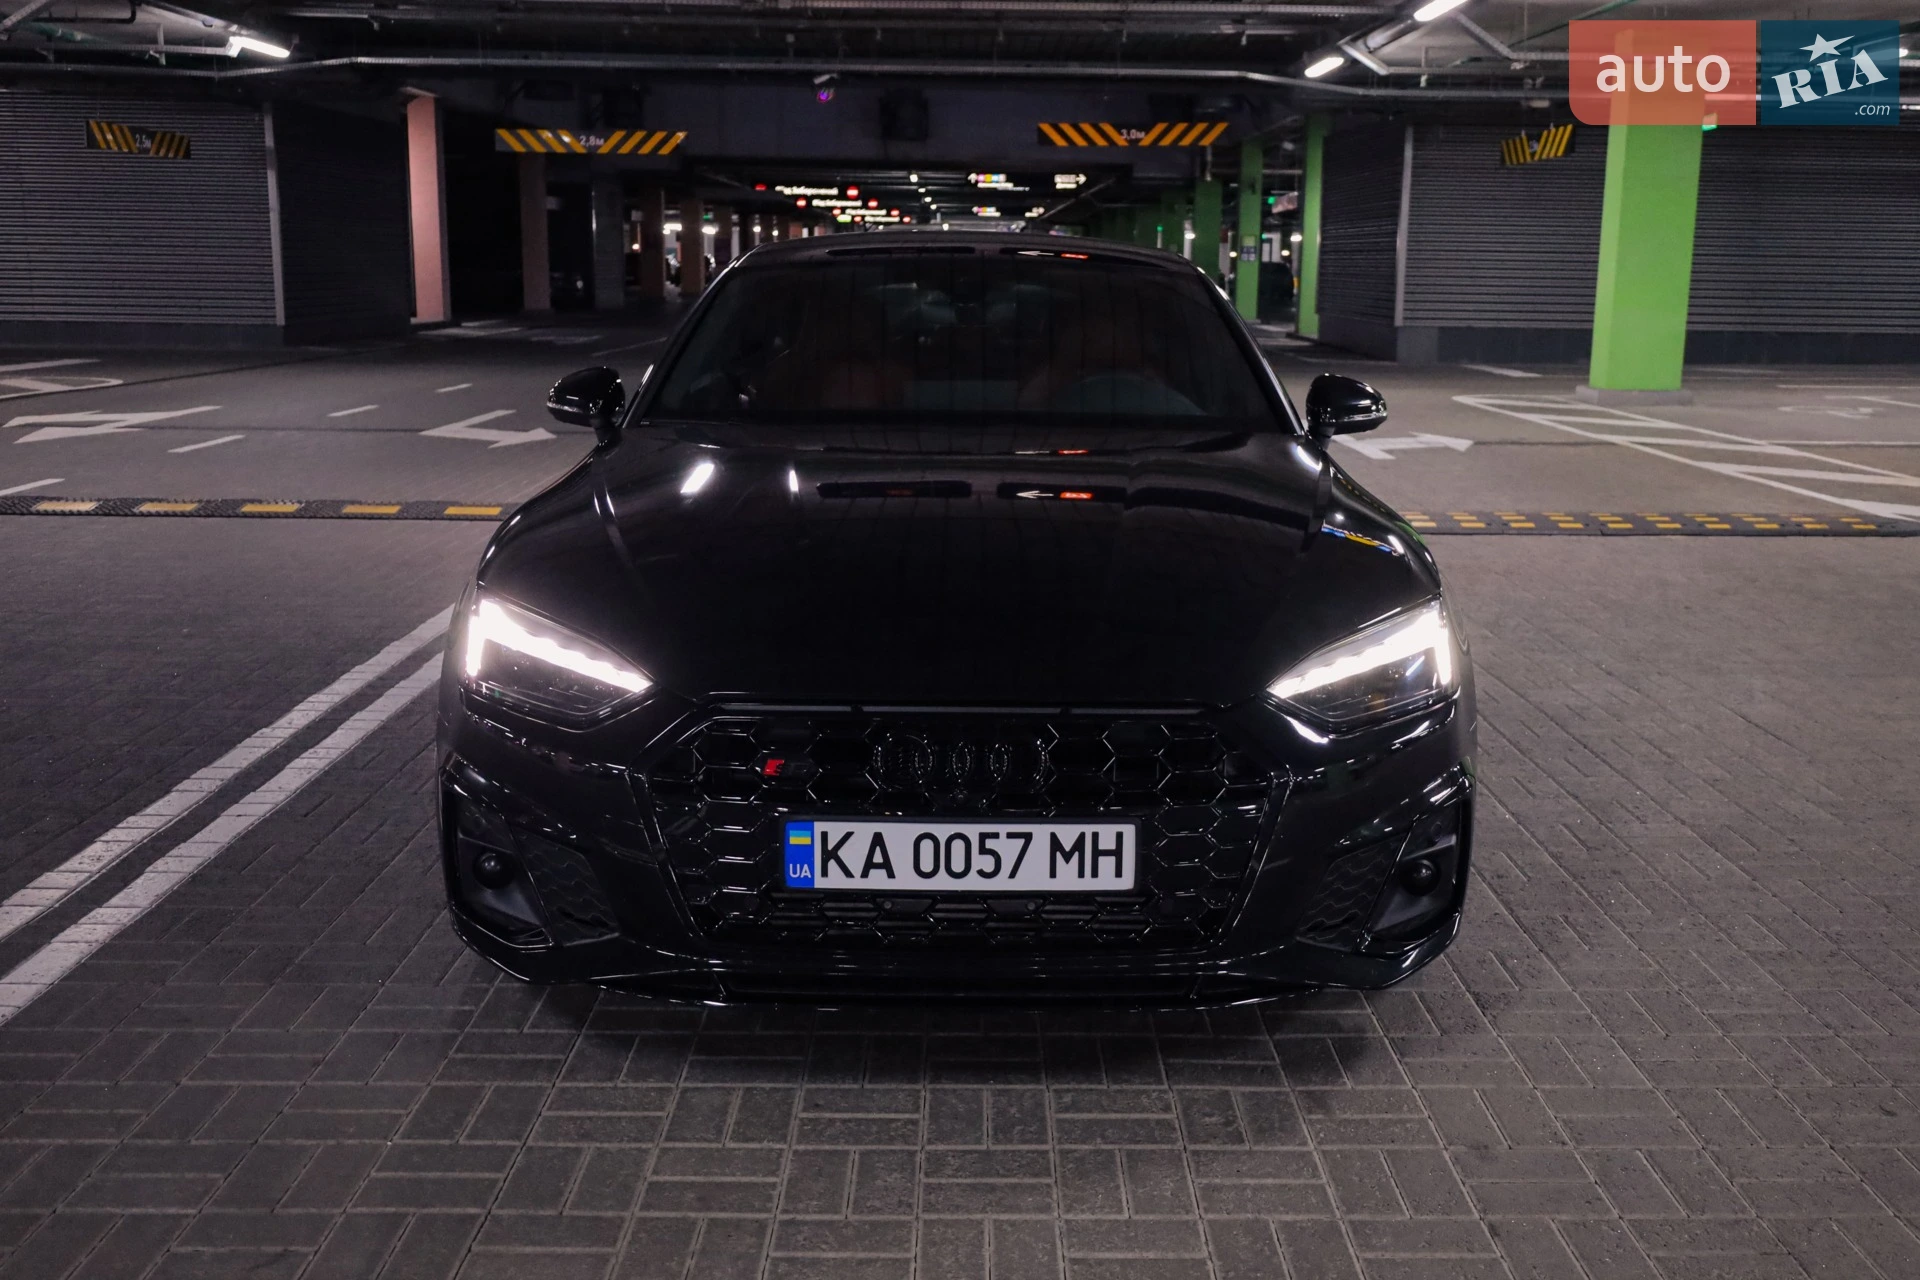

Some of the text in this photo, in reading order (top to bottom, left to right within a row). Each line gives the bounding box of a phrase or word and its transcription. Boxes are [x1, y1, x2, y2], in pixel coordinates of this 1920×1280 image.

[789, 863, 812, 879] UA
[820, 830, 1124, 880] KA 0057 MH
